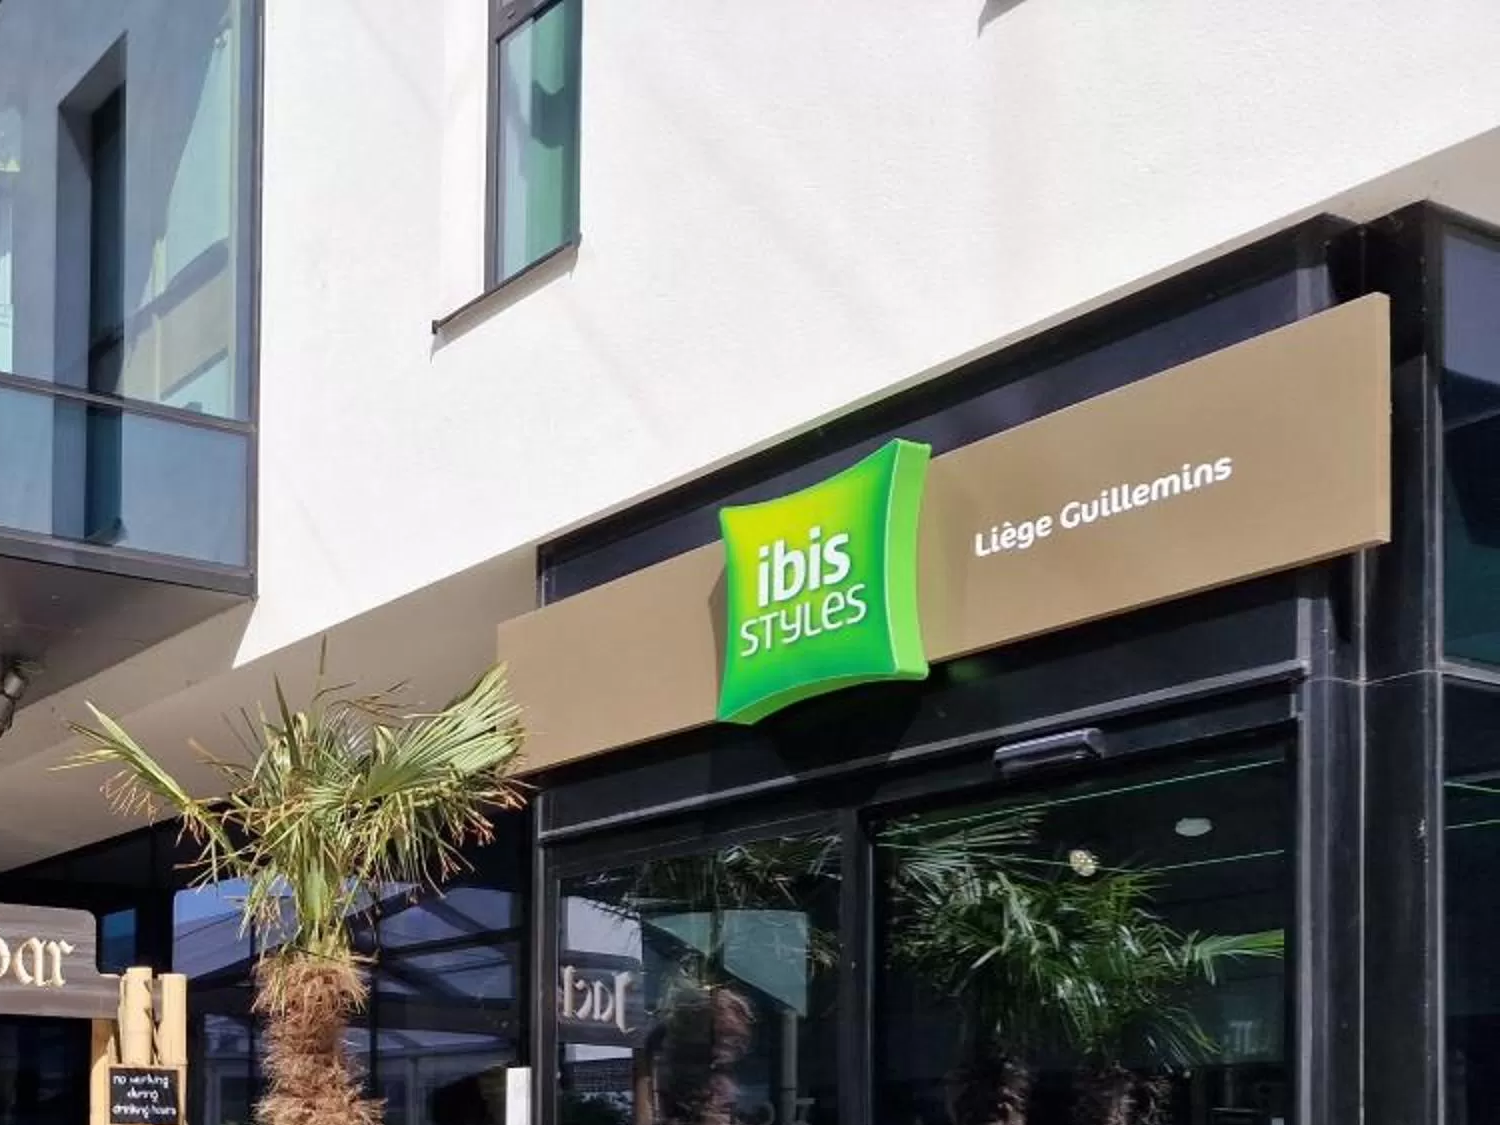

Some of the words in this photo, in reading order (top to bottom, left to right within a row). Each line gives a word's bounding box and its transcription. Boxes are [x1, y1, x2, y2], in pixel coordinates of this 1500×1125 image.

[975, 513, 1053, 557] Liège
[1059, 456, 1232, 529] Guillemins
[758, 526, 851, 609] ibis
[113, 1074, 127, 1085] no
[129, 1073, 169, 1089] working
[126, 1086, 159, 1103] during
[112, 1103, 149, 1119] drinking
[151, 1104, 177, 1116] hours
